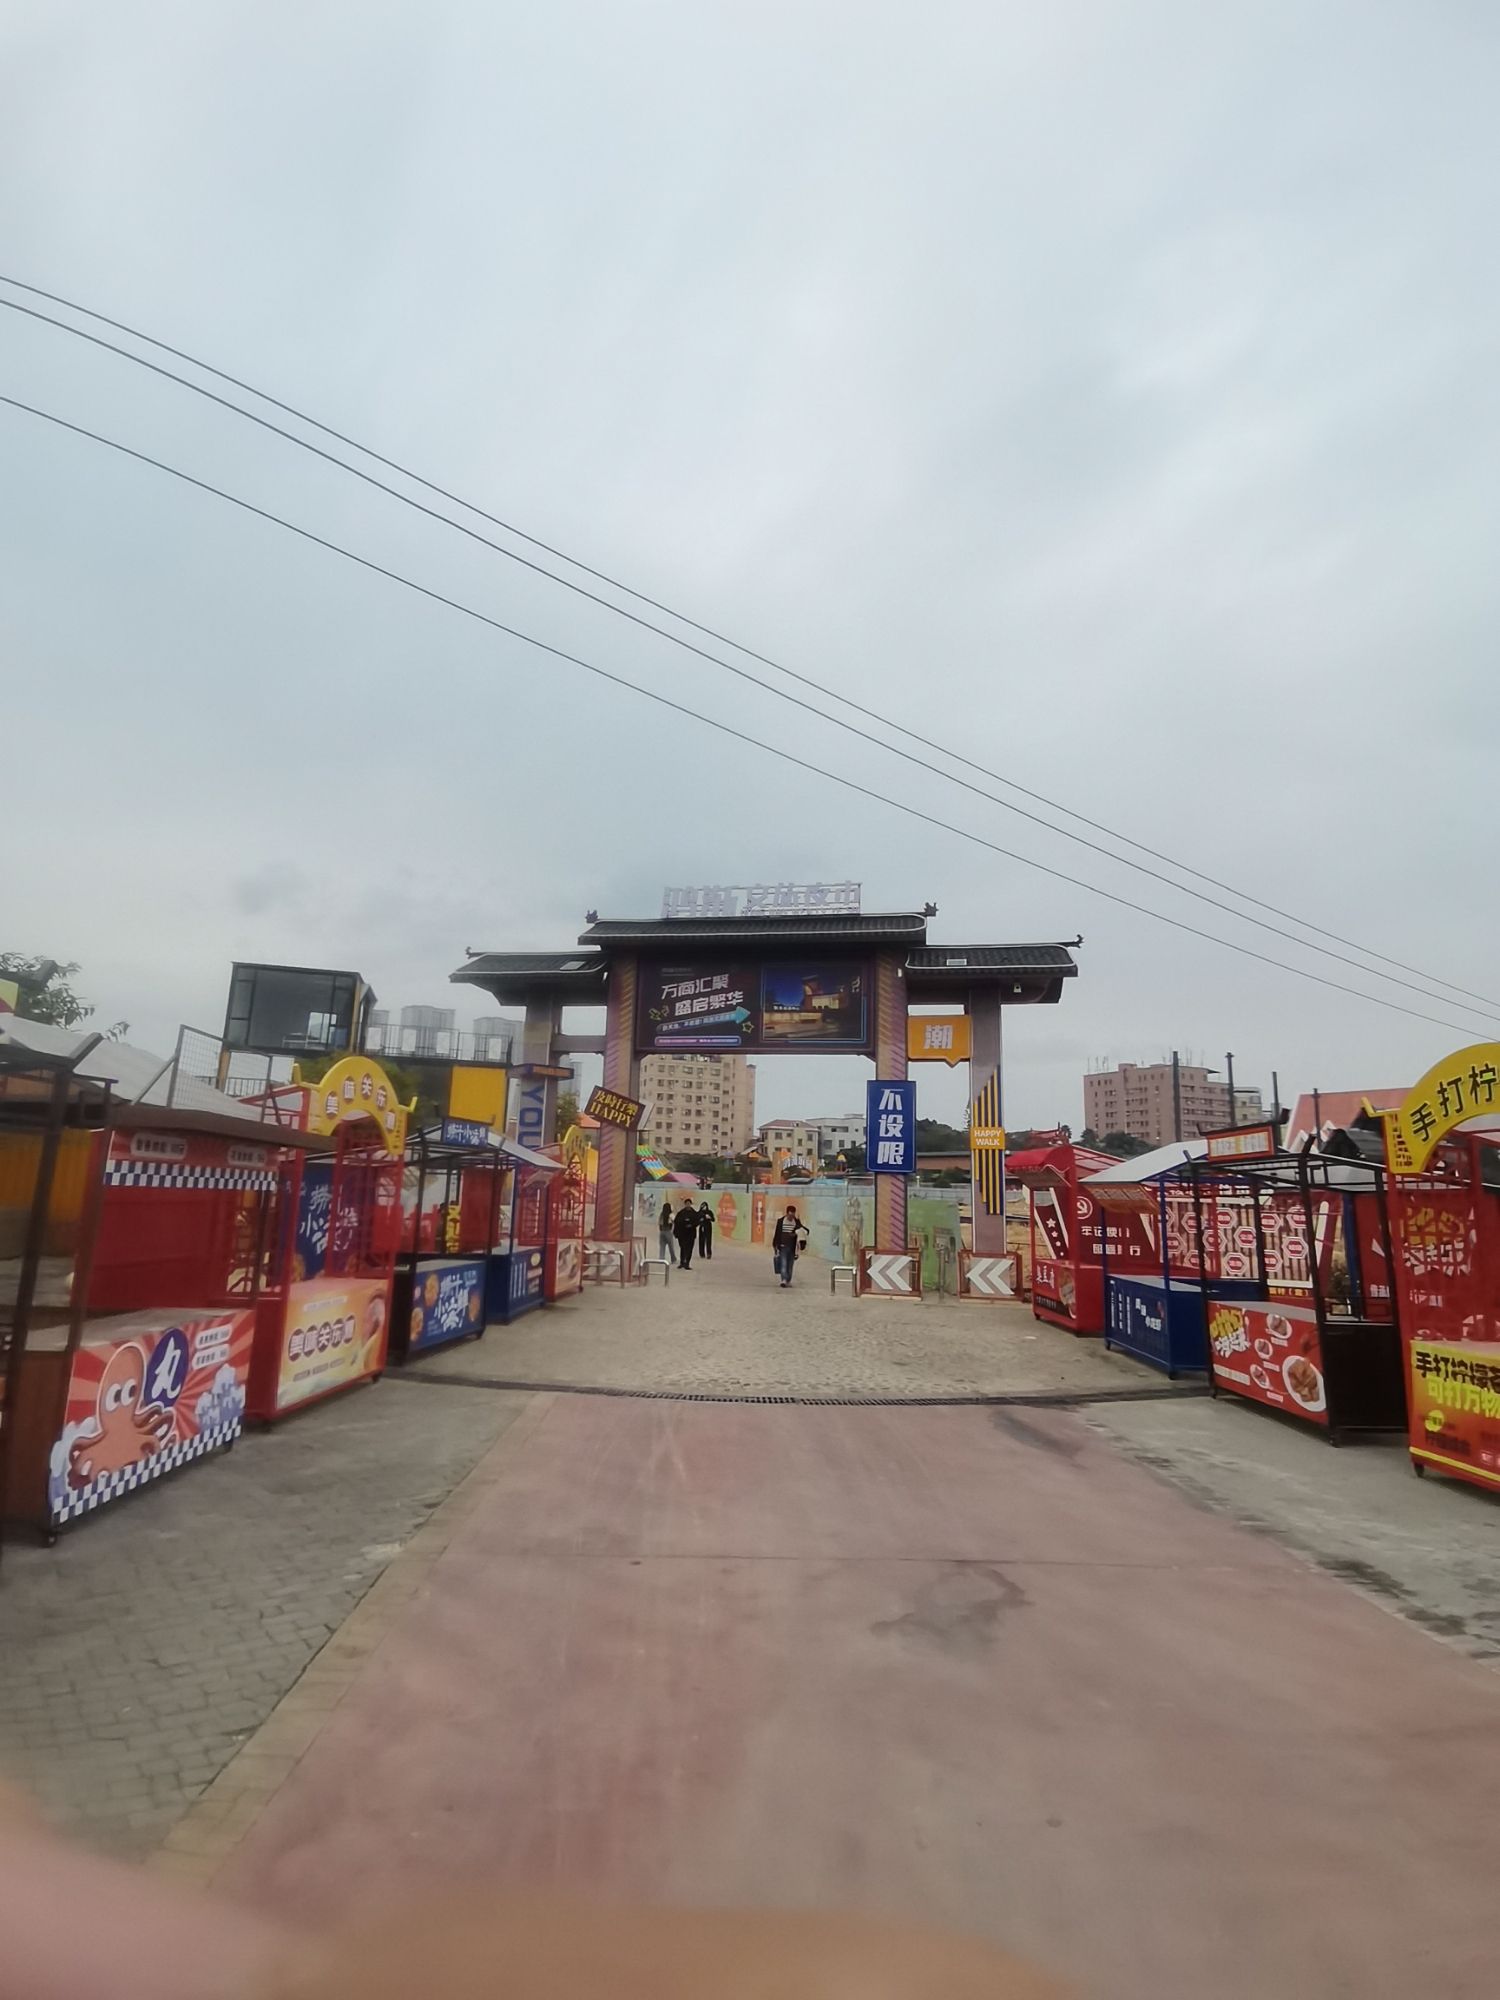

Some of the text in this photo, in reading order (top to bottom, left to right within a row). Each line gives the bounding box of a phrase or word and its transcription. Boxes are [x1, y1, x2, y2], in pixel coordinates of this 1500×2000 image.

[661, 974, 729, 1000] 万商汇聚
[674, 990, 744, 1016] 盛启繁华
[924, 1024, 953, 1049] 潮
[590, 1102, 632, 1127] HAPPY
[877, 1088, 905, 1165] 不设限
[974, 1129, 1001, 1138] HAPPY
[975, 1138, 1001, 1146] WALK
[151, 1336, 181, 1400] 丸
